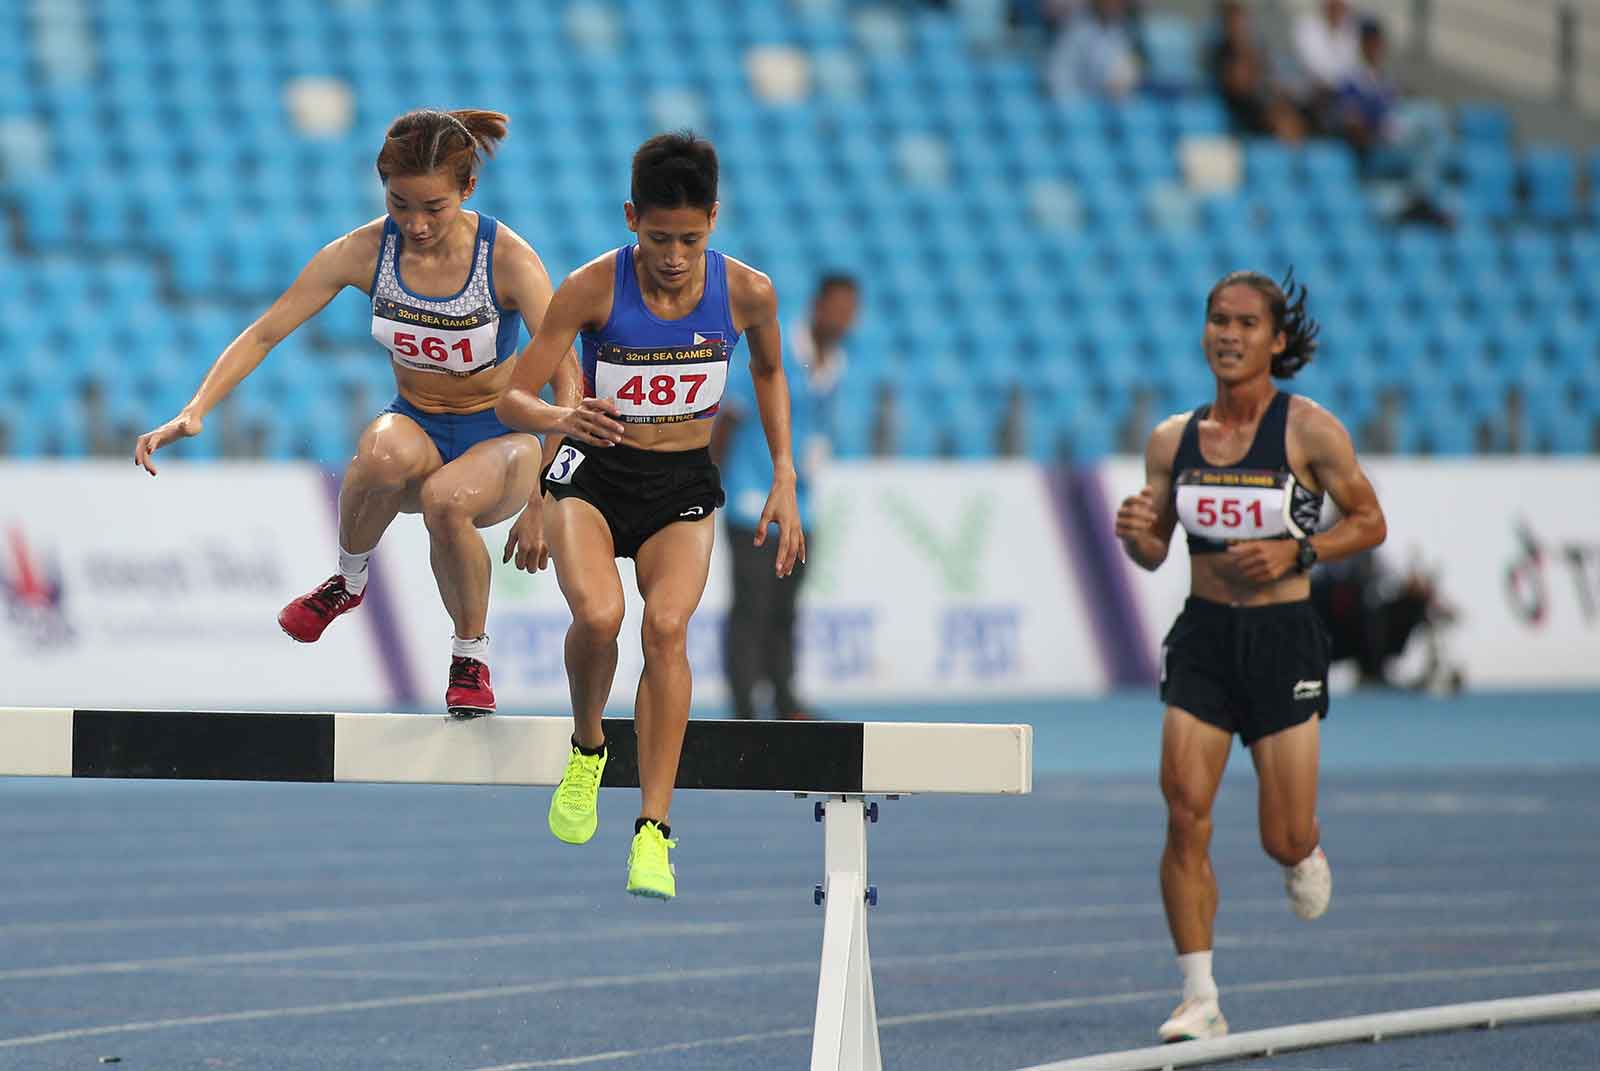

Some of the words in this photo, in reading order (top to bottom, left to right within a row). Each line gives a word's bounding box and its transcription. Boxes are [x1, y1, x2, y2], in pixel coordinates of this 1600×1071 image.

[398, 308, 420, 321] 32nd
[421, 313, 440, 325] SEA
[442, 316, 478, 327] GAMES
[393, 331, 474, 363] 561
[625, 352, 650, 361] 32nd
[652, 351, 673, 361] SEA
[675, 348, 713, 360] GAMES
[616, 373, 708, 405] 487
[549, 447, 577, 480] 3
[1195, 498, 1263, 528] 551
